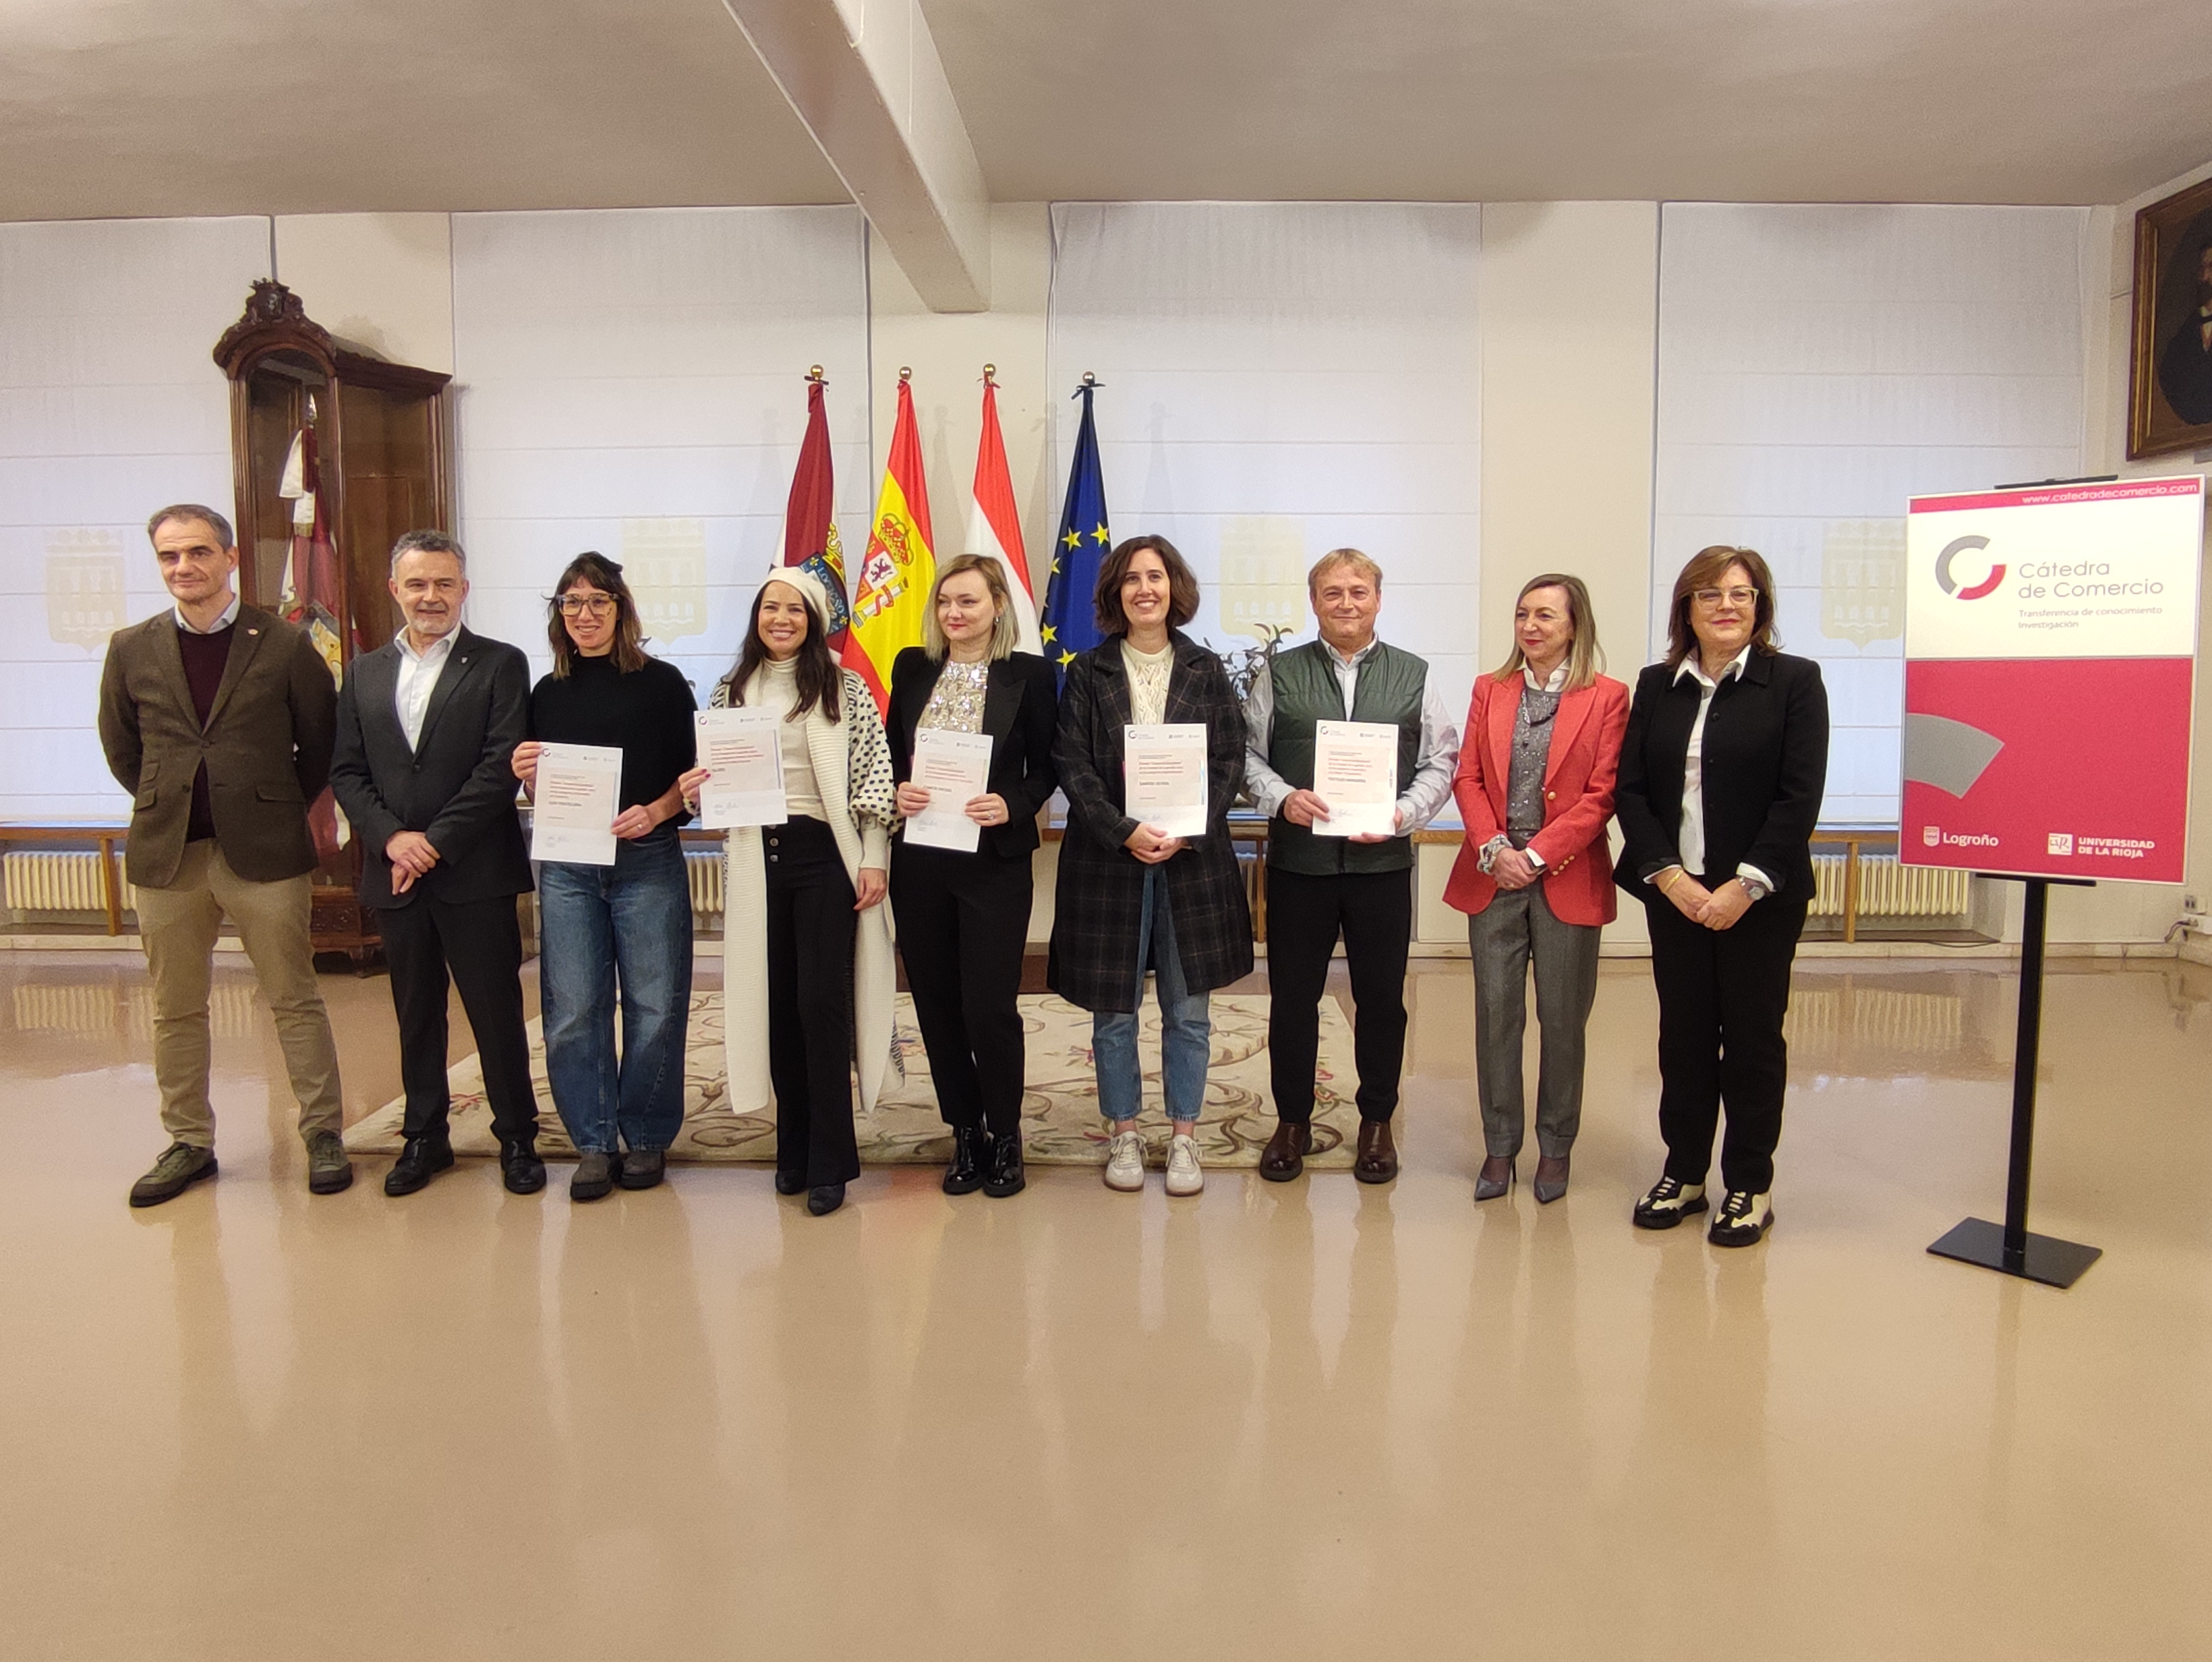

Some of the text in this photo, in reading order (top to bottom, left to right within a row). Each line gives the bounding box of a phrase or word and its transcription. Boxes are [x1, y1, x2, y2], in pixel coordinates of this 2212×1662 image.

[2022, 484, 2197, 503] www.catedradecomercio.com
[2018, 561, 2110, 579] Cátedra
[2018, 578, 2164, 598] de Comercio
[2018, 606, 2163, 618] Transferencia de conocimiento
[2018, 621, 2079, 630] Investigación
[1943, 832, 1999, 847] Logroño
[2078, 837, 2155, 849] UNIVERSIDAD
[2078, 846, 2144, 859] DE LA RIOJA
